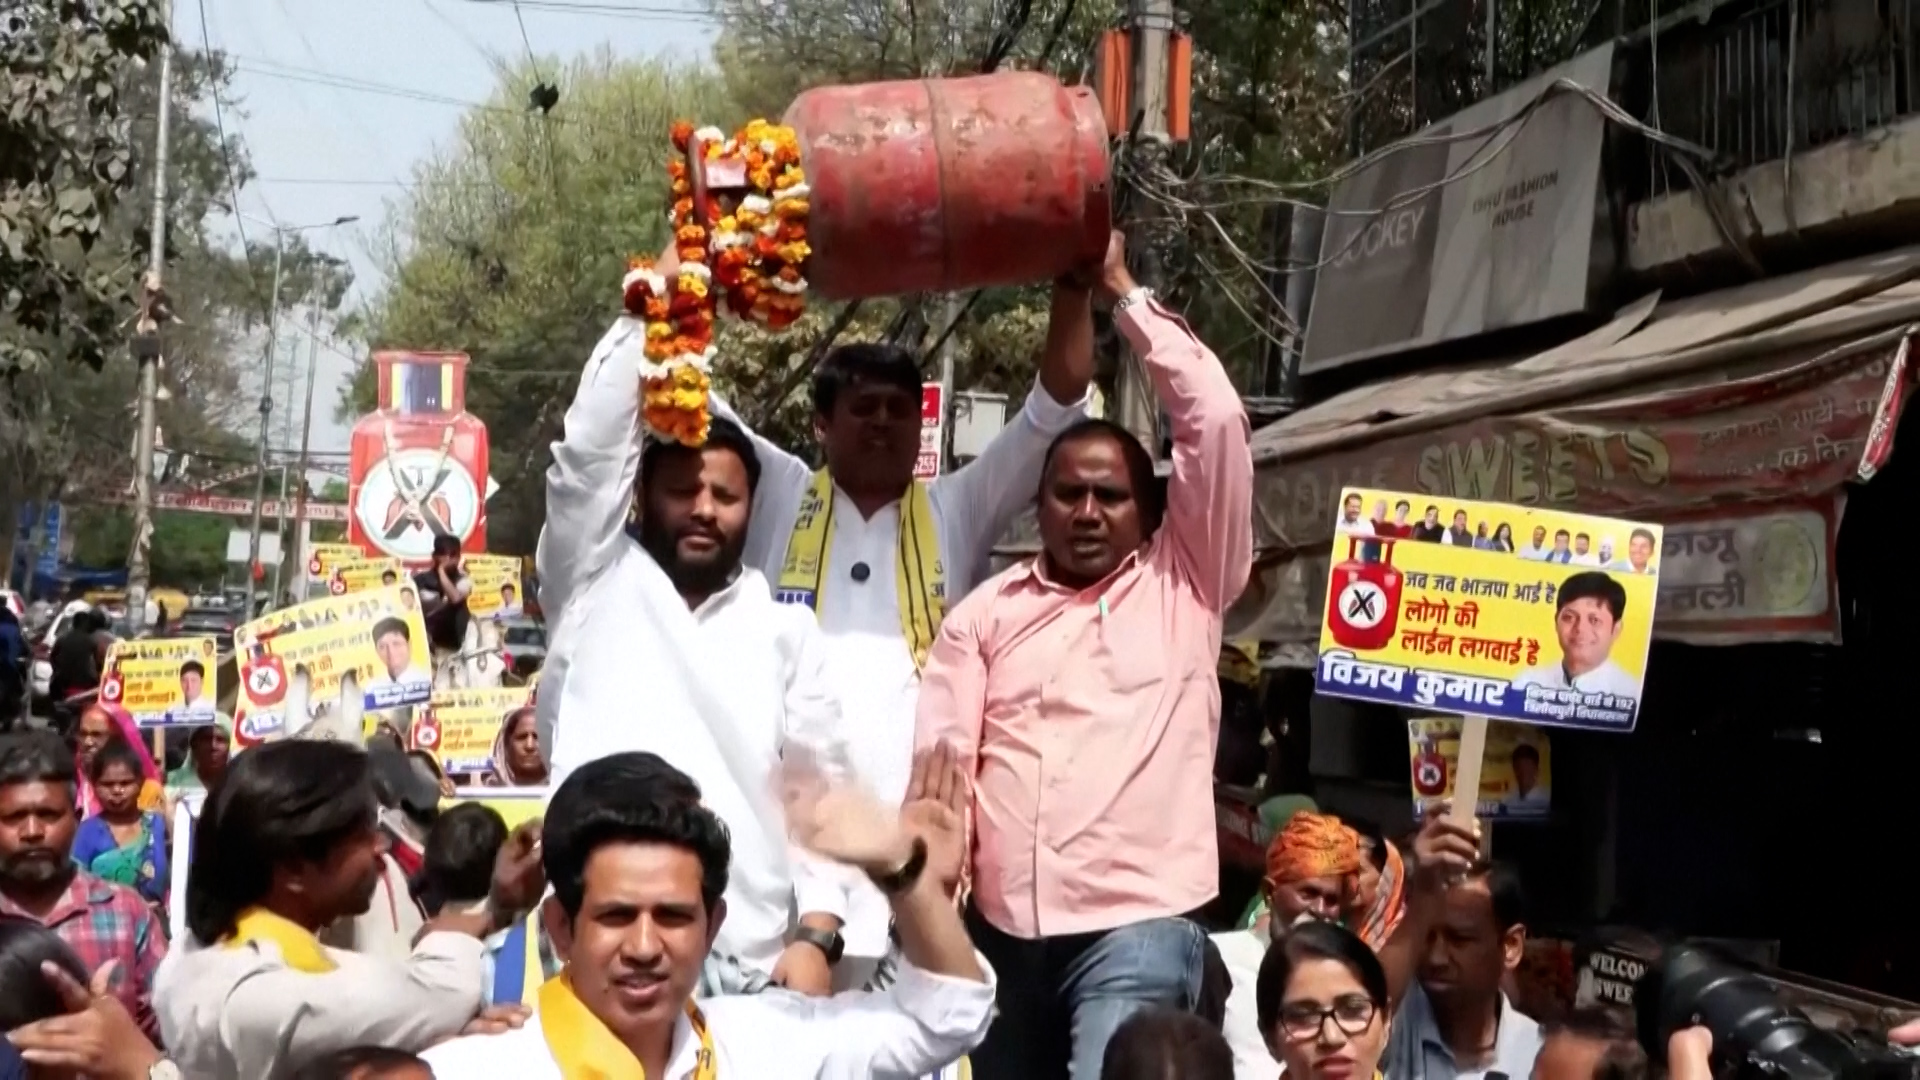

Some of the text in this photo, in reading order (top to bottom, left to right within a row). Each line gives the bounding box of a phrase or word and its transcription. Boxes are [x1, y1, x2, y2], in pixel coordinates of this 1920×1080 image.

[1492, 199, 1535, 229] HOUSE
[1415, 427, 1671, 501] SWEETS
[1460, 577, 1509, 598] भाजपा
[1513, 580, 1543, 604] आई
[1545, 582, 1557, 604] है
[1404, 596, 1480, 629] लोगो की
[1400, 627, 1541, 666] लाईन लगवाई है
[1321, 650, 1510, 706] विजय कुमार
